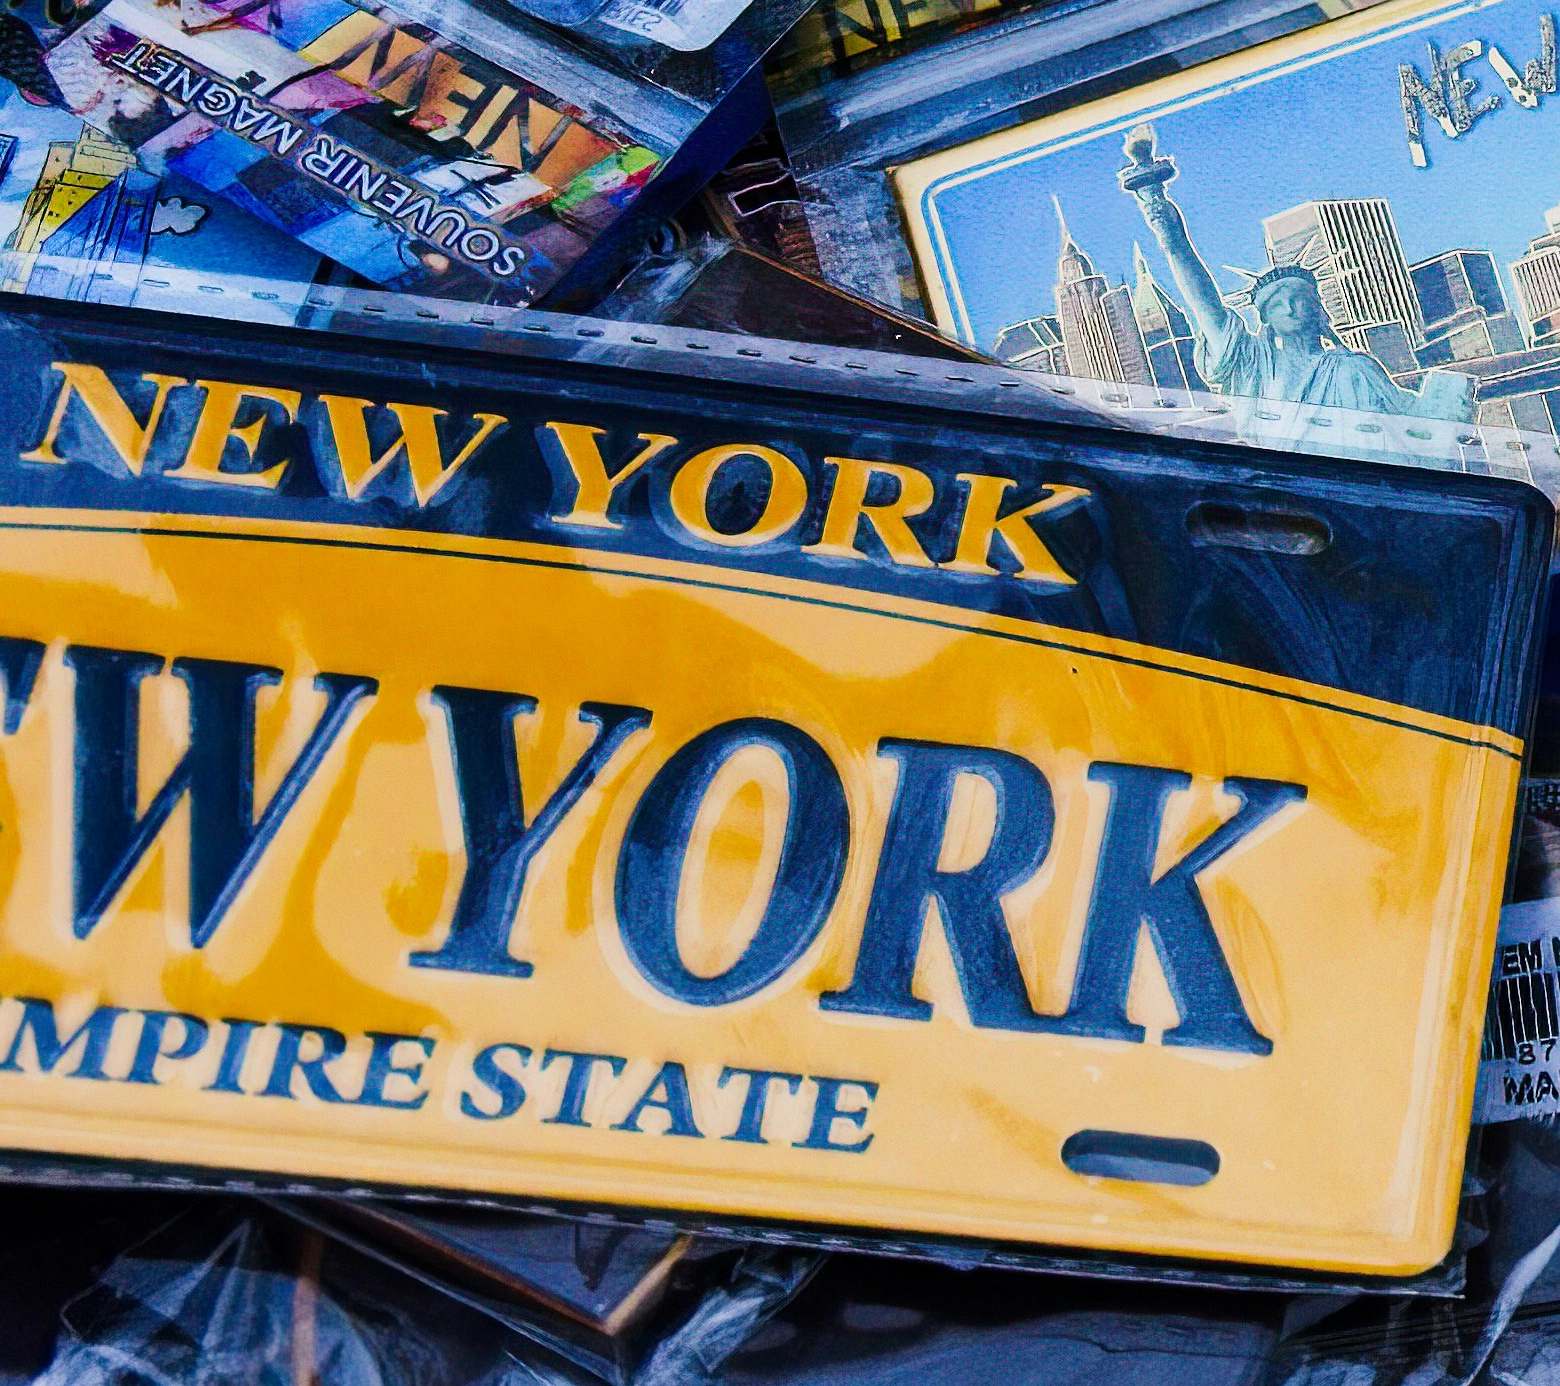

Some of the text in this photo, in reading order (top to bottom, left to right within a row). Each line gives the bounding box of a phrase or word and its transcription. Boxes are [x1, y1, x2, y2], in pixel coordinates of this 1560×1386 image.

[104, 42, 525, 281] SOUVENIR MAGNET
[1397, 13, 1560, 168] NEW
[19, 361, 1094, 588] NEW YORK
[405, 685, 1309, 1051] YORK
[457, 1032, 879, 1155] STATE
